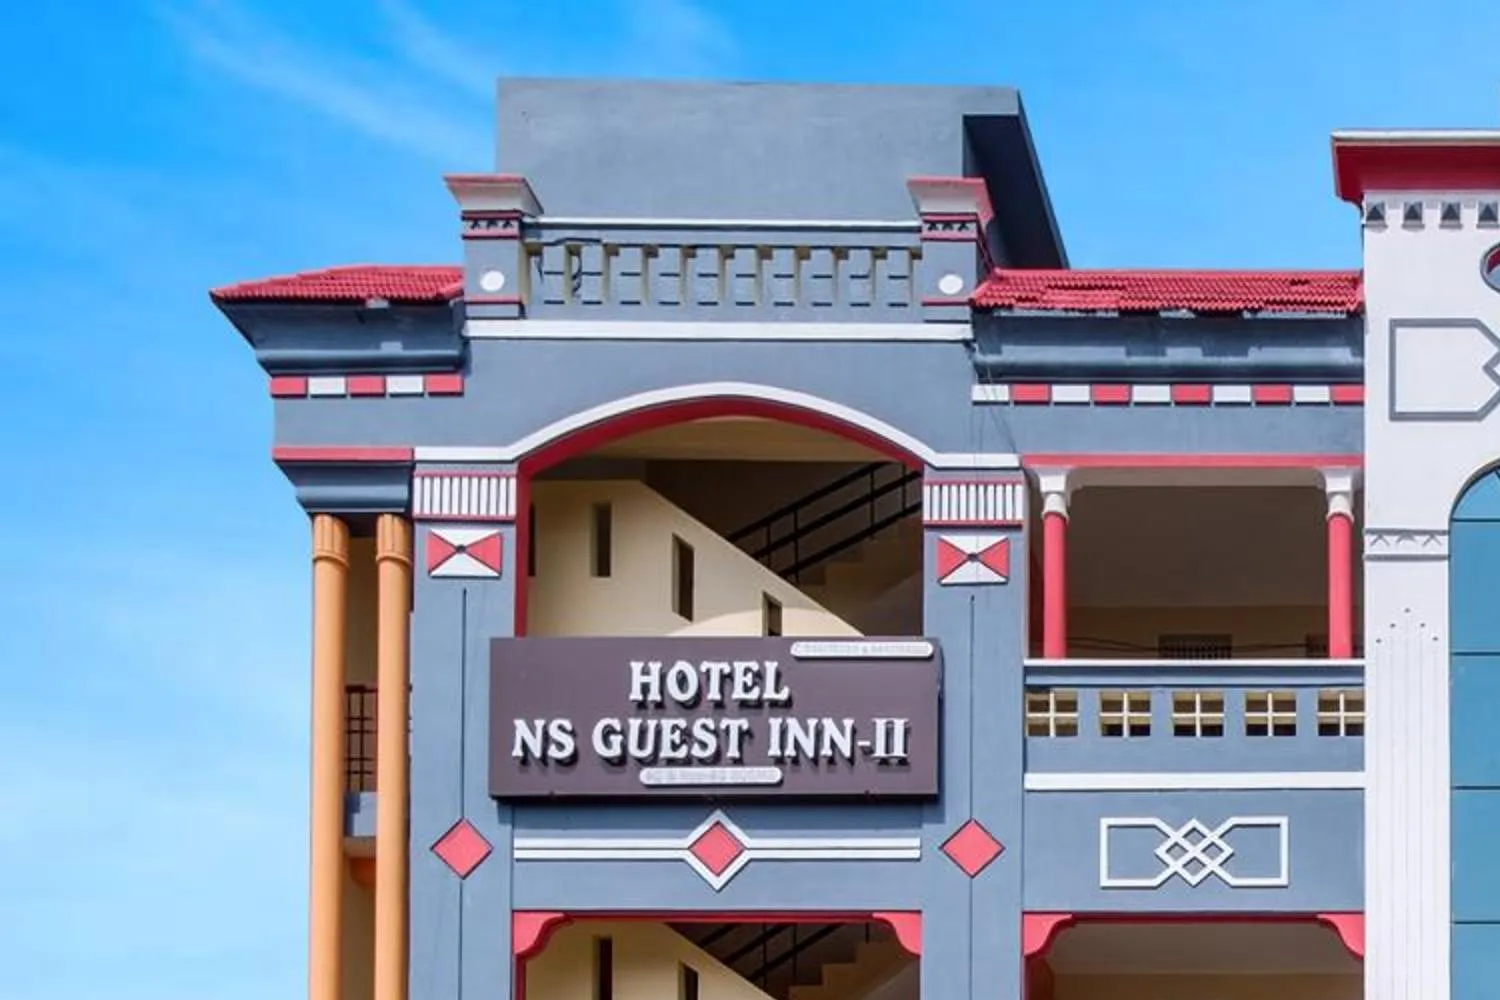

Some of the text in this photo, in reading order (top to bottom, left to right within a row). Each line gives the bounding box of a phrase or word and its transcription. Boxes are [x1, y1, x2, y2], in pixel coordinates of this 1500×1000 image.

[628, 660, 791, 702] HOTEL
[511, 717, 909, 760] NS GUEST INN-II
